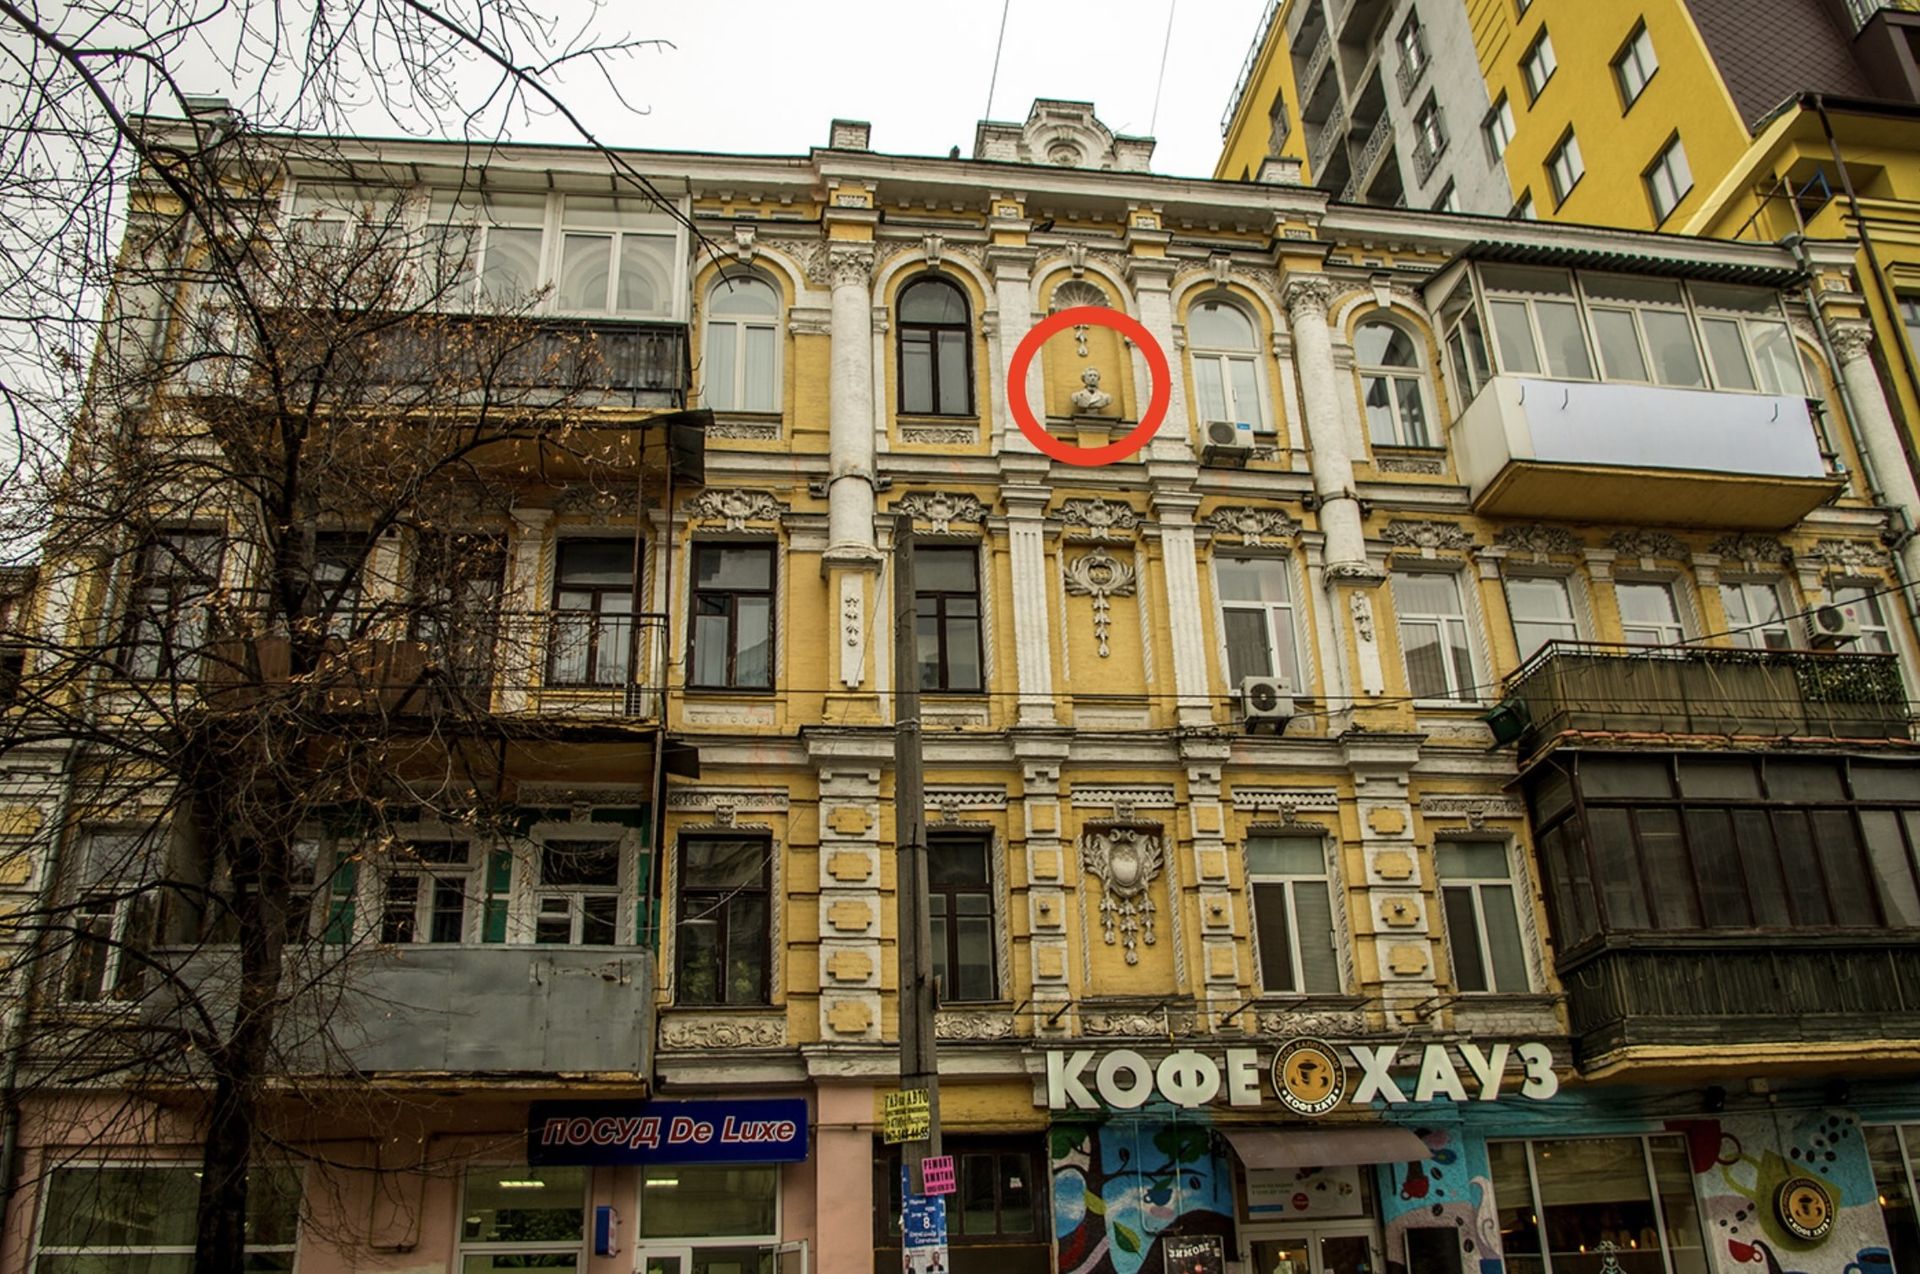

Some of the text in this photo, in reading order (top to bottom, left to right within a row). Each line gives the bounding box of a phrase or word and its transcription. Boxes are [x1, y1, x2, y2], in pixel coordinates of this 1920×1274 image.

[1046, 1042, 1559, 1111] КОФЕ ХАУЗ
[907, 1089, 929, 1105] АВТО
[1285, 1093, 1337, 1112] КОФЕ ХАУЗ
[541, 1115, 796, 1149] ПОСУД De Luxe
[924, 1157, 952, 1170] РЕМОНТ
[923, 1216, 930, 1229] 8
